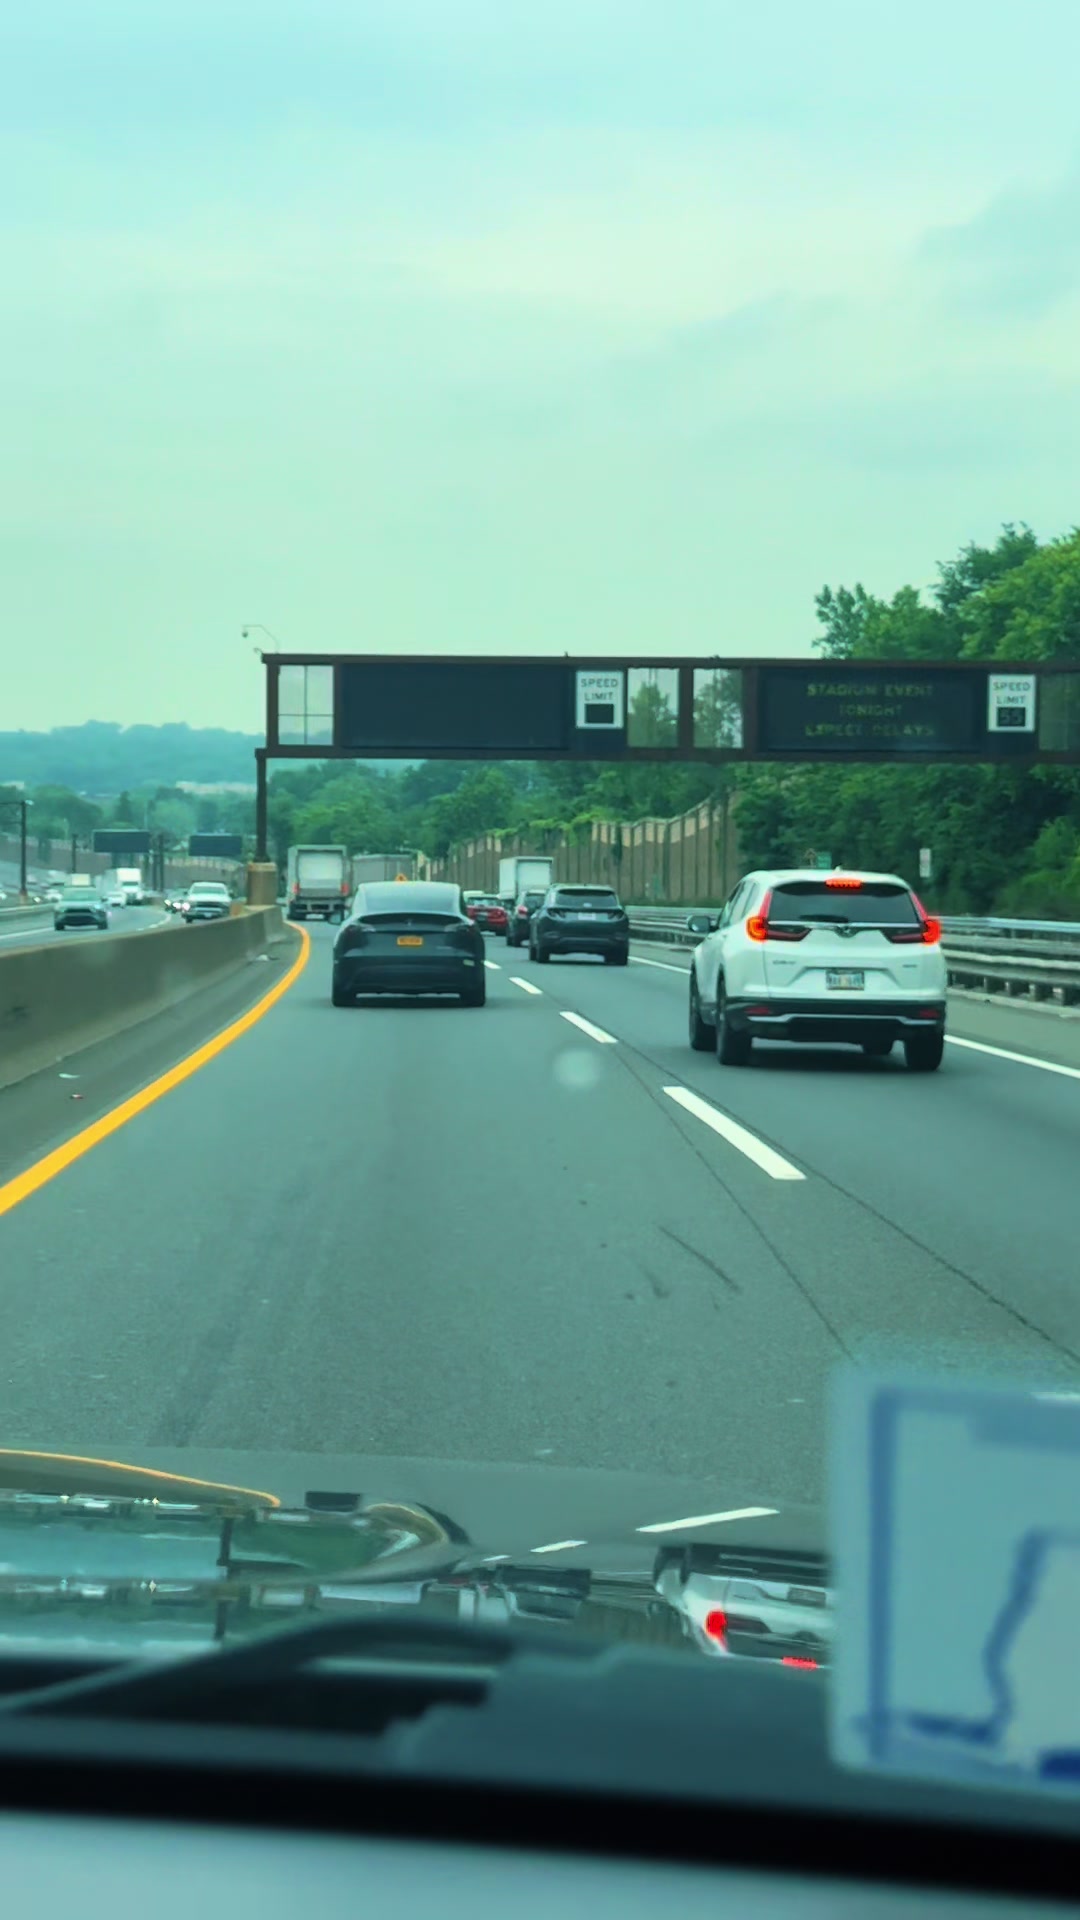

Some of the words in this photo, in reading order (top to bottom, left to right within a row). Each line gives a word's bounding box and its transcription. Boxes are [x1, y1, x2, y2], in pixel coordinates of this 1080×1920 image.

[580, 678, 619, 688] SPEED
[992, 681, 1031, 691] SPEED
[806, 683, 877, 697] STADIUM
[884, 683, 933, 697] EVENT
[584, 691, 614, 701] LIMIT
[996, 695, 1026, 705] LIMIT
[839, 703, 902, 716] TONIGHT
